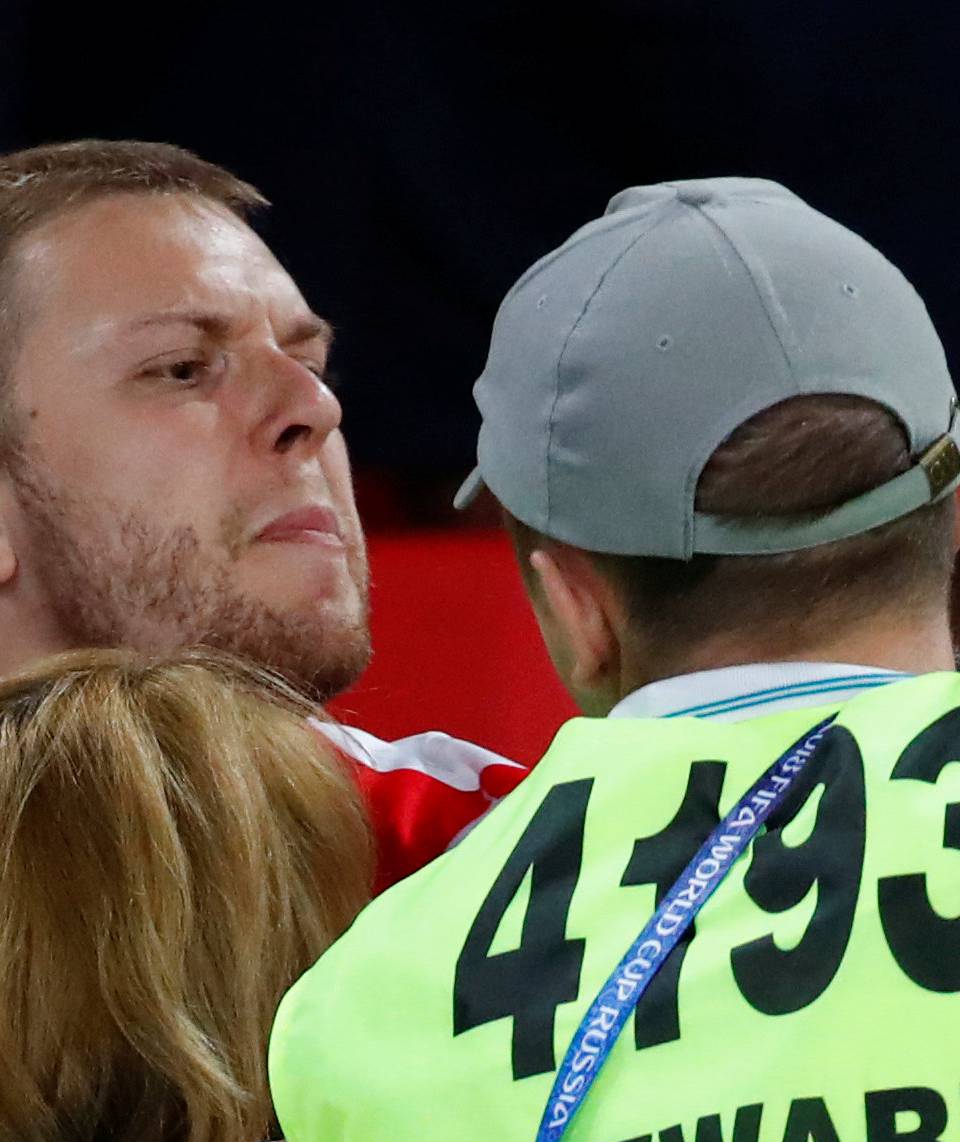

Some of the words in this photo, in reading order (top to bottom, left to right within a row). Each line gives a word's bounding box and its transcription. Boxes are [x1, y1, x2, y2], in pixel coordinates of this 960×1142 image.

[729, 775, 790, 828] FIFA
[453, 706, 960, 1081] 4193
[656, 834, 741, 937] WORLD
[615, 938, 662, 1002] CUP
[548, 1005, 620, 1129] RUSSIA
